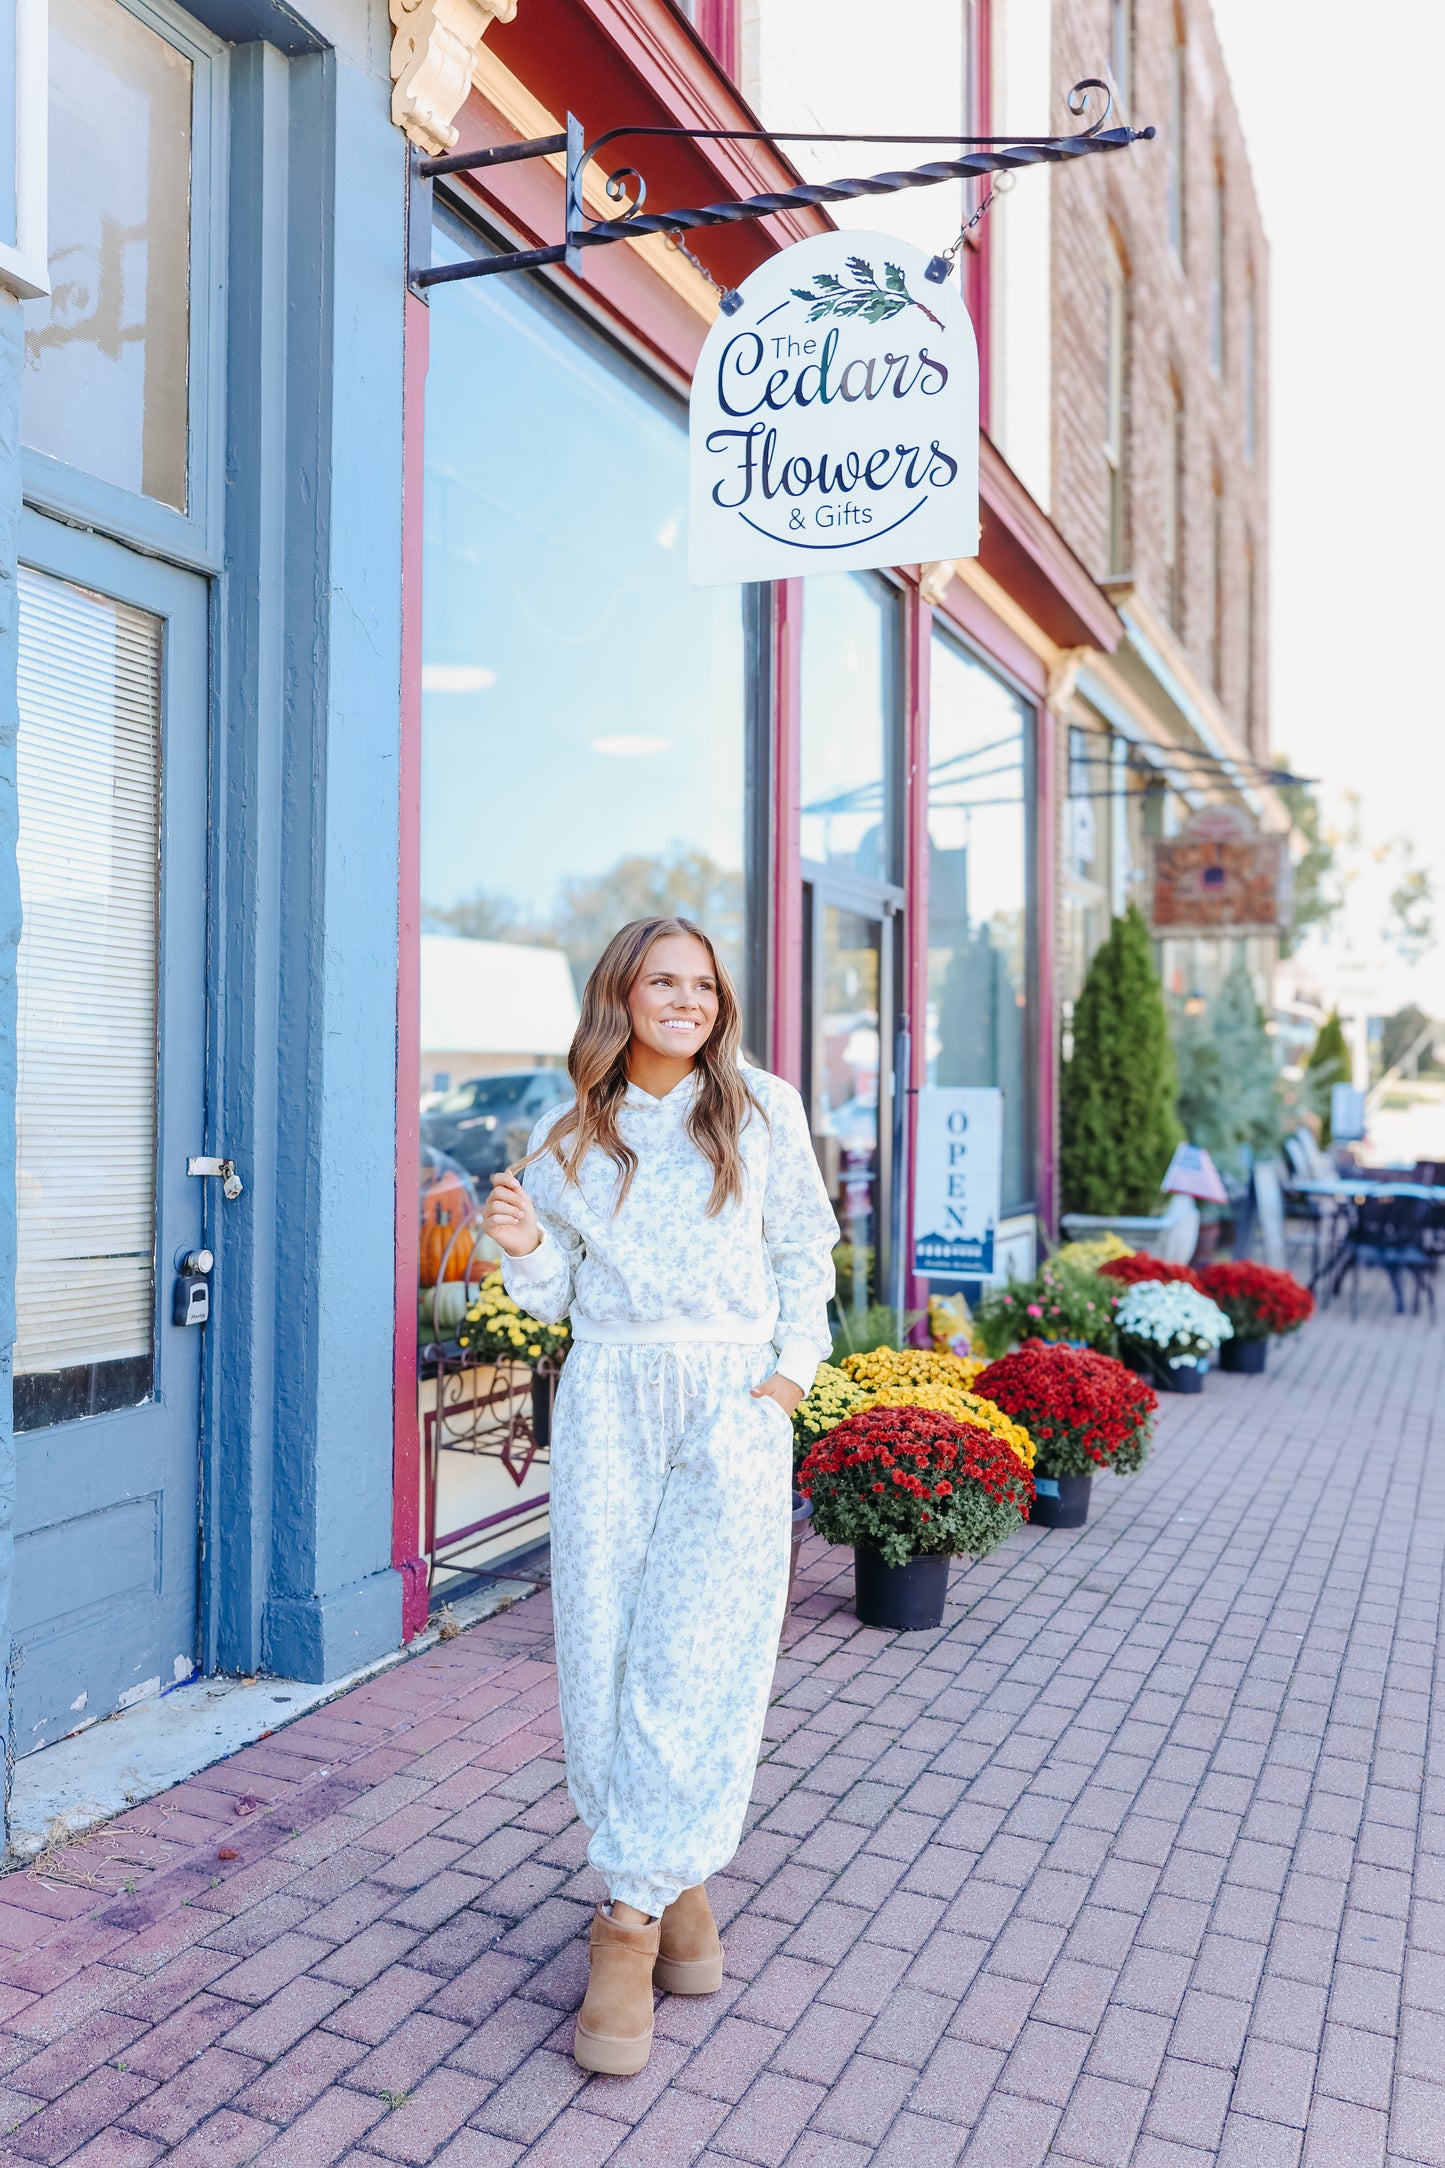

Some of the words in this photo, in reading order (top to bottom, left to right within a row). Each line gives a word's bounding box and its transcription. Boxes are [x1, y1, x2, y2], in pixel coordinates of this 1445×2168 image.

[718, 328, 948, 416] Cedars
[771, 335, 817, 358] The
[706, 422, 958, 507] Flowers
[789, 508, 806, 530] &
[815, 501, 873, 527] Gifts
[945, 1111, 968, 1229] OPEN
